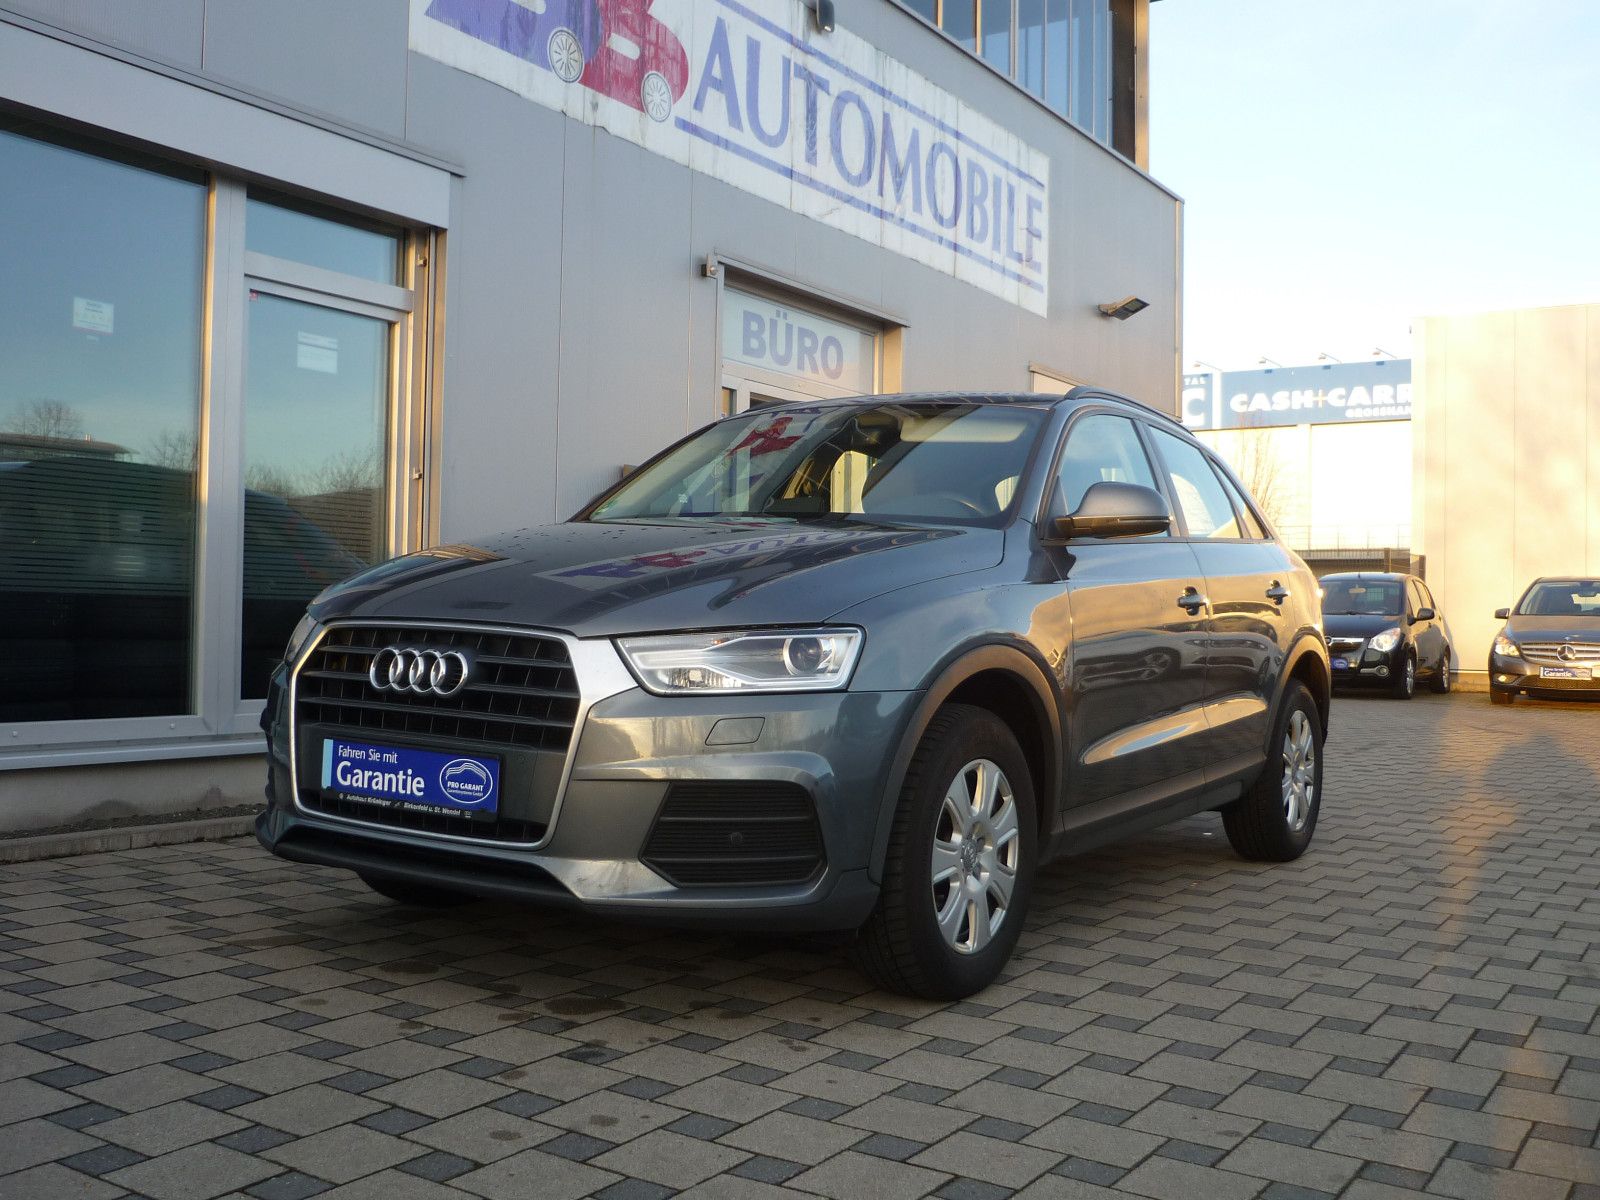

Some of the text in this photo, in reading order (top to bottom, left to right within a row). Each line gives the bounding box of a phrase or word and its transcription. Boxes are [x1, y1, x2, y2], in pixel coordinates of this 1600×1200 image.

[693, 15, 1043, 272] AUTOMOBILE
[742, 309, 844, 380] BÜRO
[338, 745, 398, 764] Fahren Sie mit
[336, 760, 425, 796] Garantie
[447, 781, 484, 792] PRO GARANT
